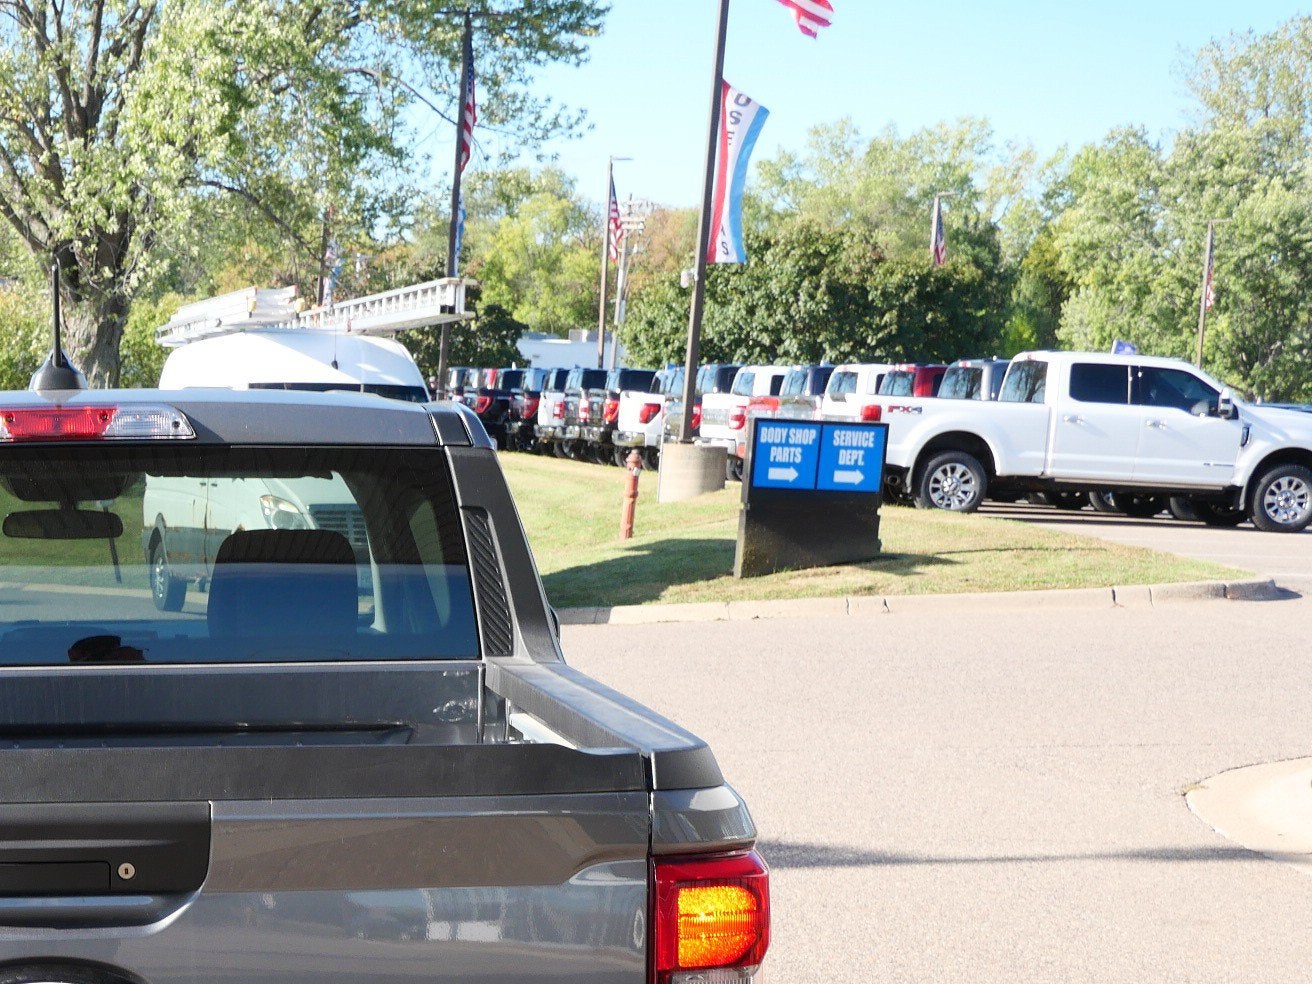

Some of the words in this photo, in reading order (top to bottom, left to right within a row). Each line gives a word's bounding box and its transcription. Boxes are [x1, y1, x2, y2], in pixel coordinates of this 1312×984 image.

[759, 426, 788, 444] BODY
[788, 428, 817, 445] SHOP
[832, 430, 875, 448] SERVICE
[769, 446, 802, 463] PARTS
[838, 449, 865, 466] DEPT.
